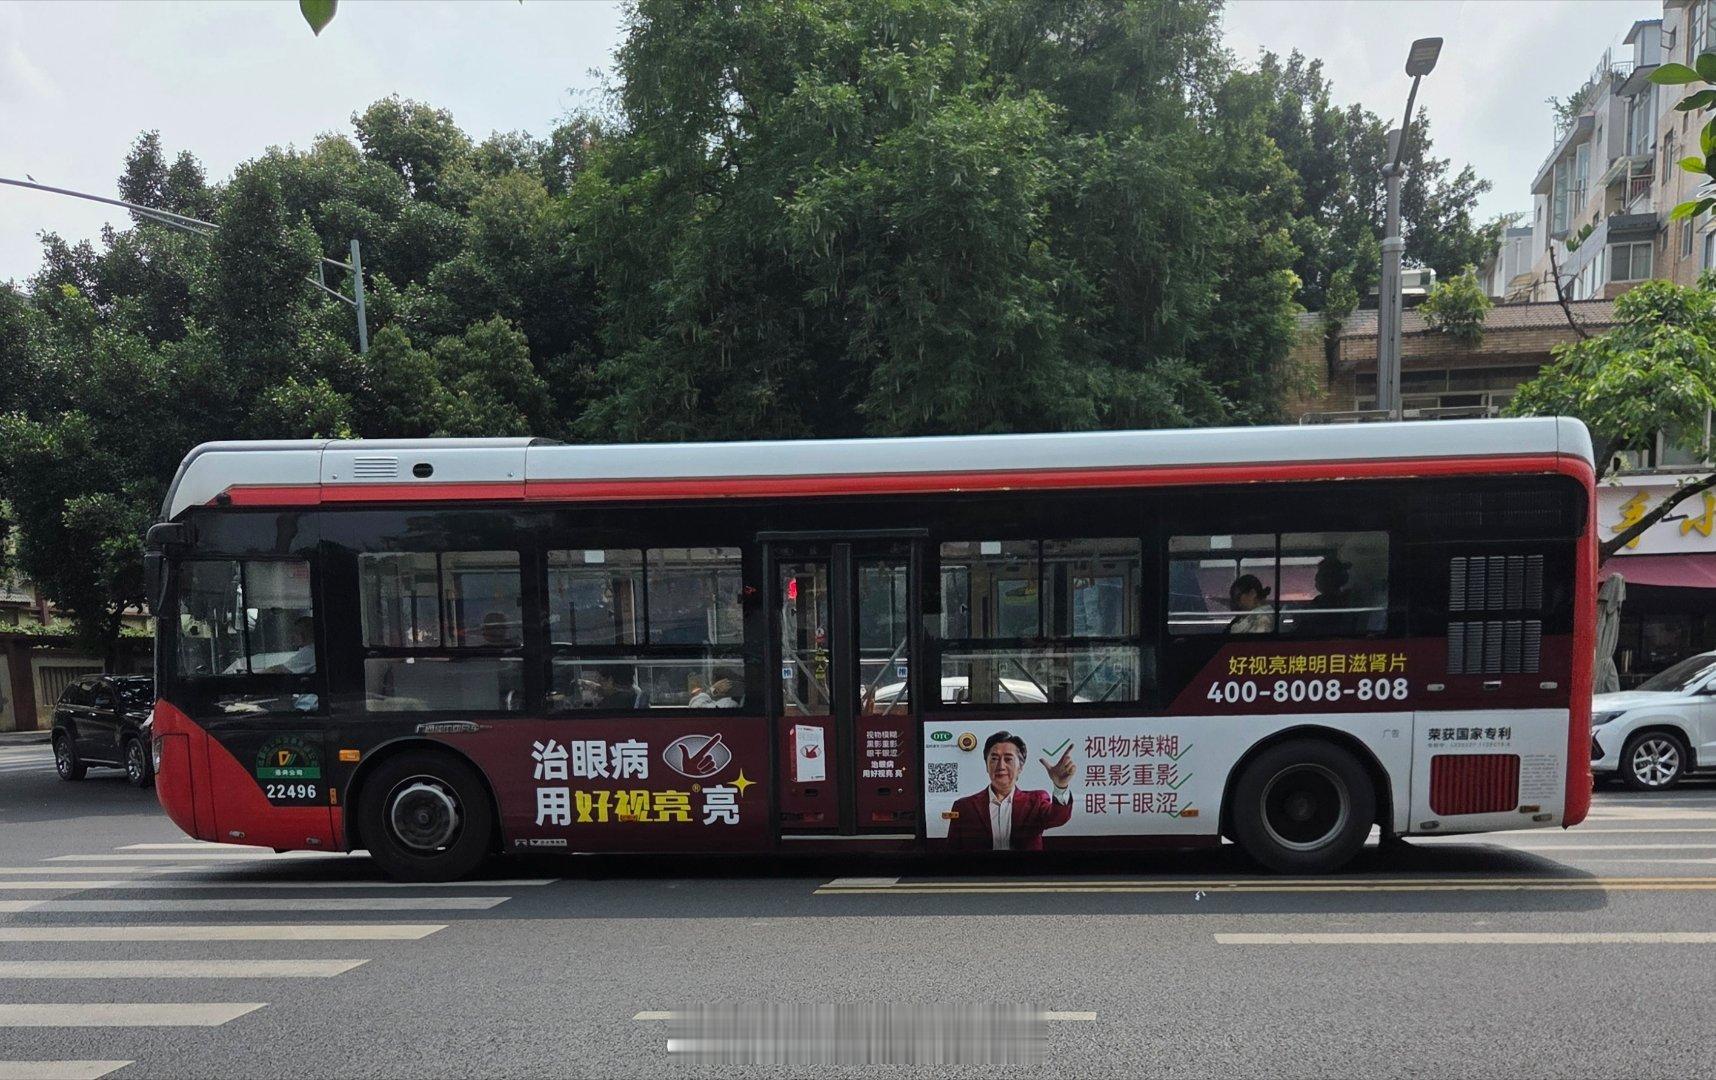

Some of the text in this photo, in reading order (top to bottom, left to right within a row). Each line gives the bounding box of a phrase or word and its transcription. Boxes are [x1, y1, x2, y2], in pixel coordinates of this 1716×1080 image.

[1228, 653, 1408, 675] 好视亮牌明目滋肾片
[1206, 678, 1408, 703] 400-8008-808
[1428, 727, 1512, 741] 荣获国家专利
[1084, 735, 1179, 758] 视物模糊
[531, 739, 649, 780] 治眼病
[1084, 763, 1179, 787] 黑影重影
[266, 784, 318, 799] 22496
[1085, 792, 1179, 815] 眼干眼涩
